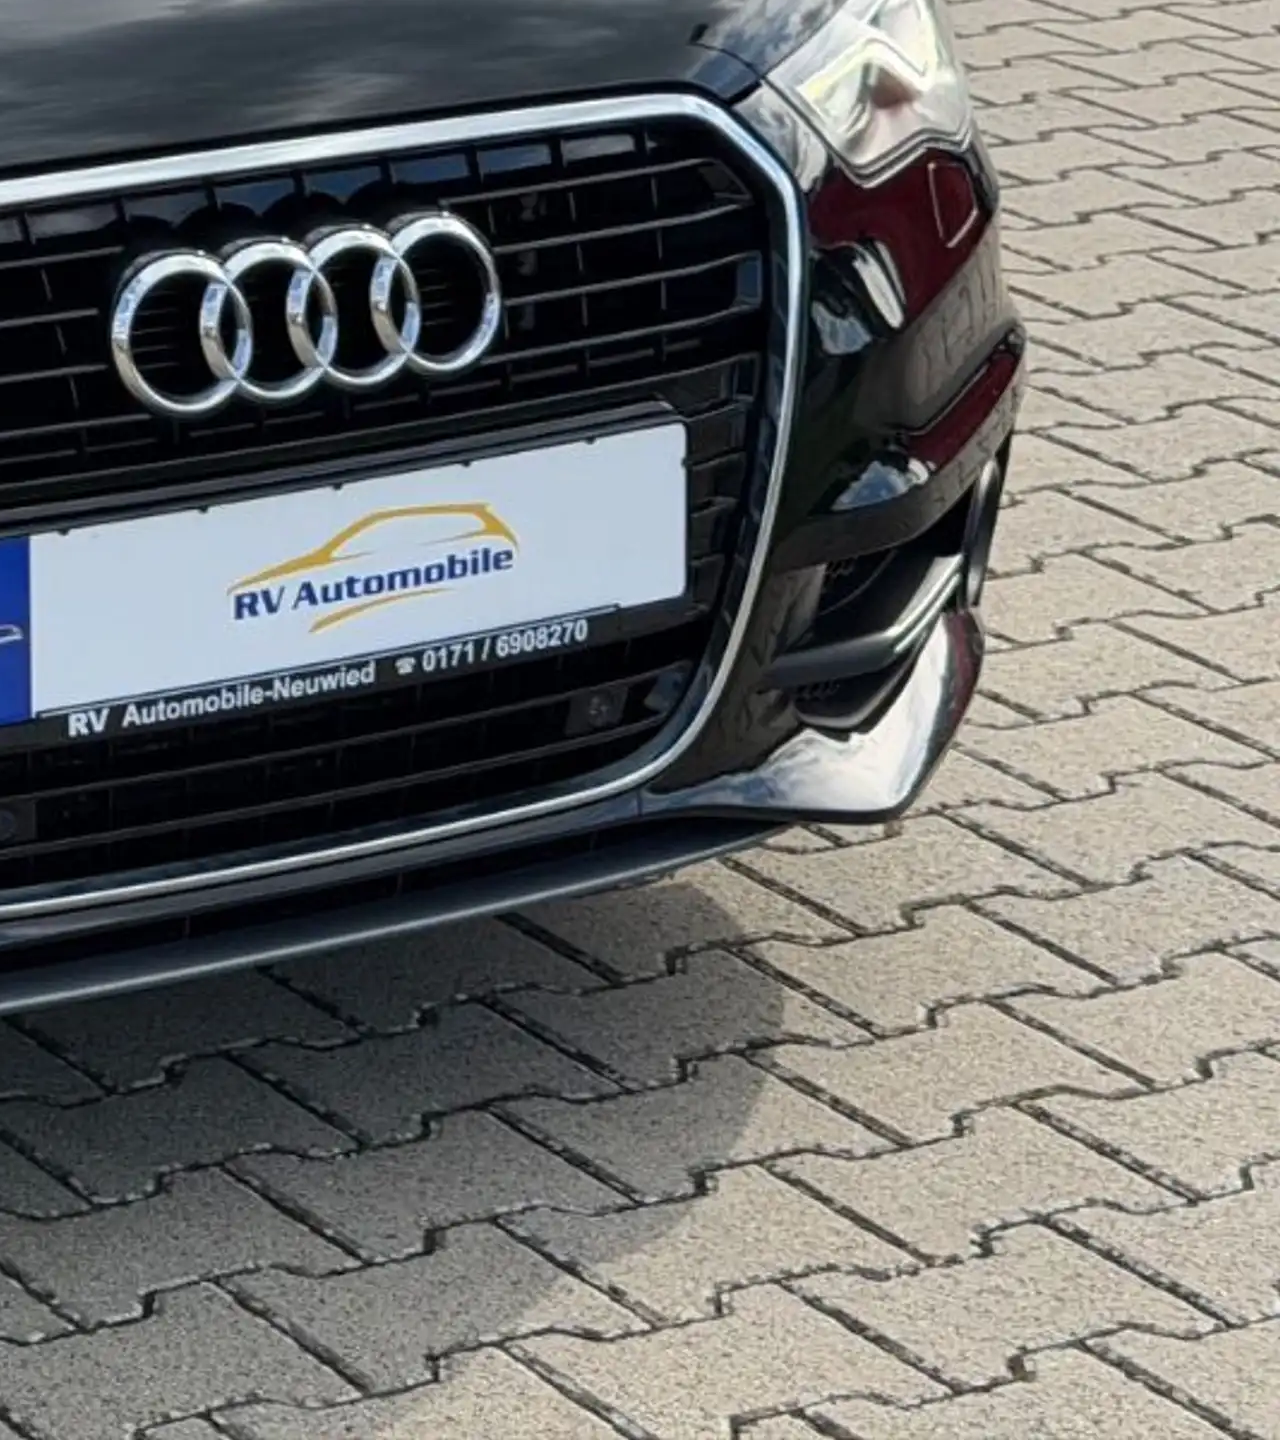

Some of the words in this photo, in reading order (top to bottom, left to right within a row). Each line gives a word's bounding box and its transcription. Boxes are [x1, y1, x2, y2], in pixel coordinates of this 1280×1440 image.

[233, 586, 285, 620] RV
[291, 547, 514, 610] Automobile
[67, 707, 111, 738] RV
[120, 660, 377, 729] Automobile-Neuwied
[421, 641, 476, 672] 0171
[495, 618, 589, 658] 6908270
